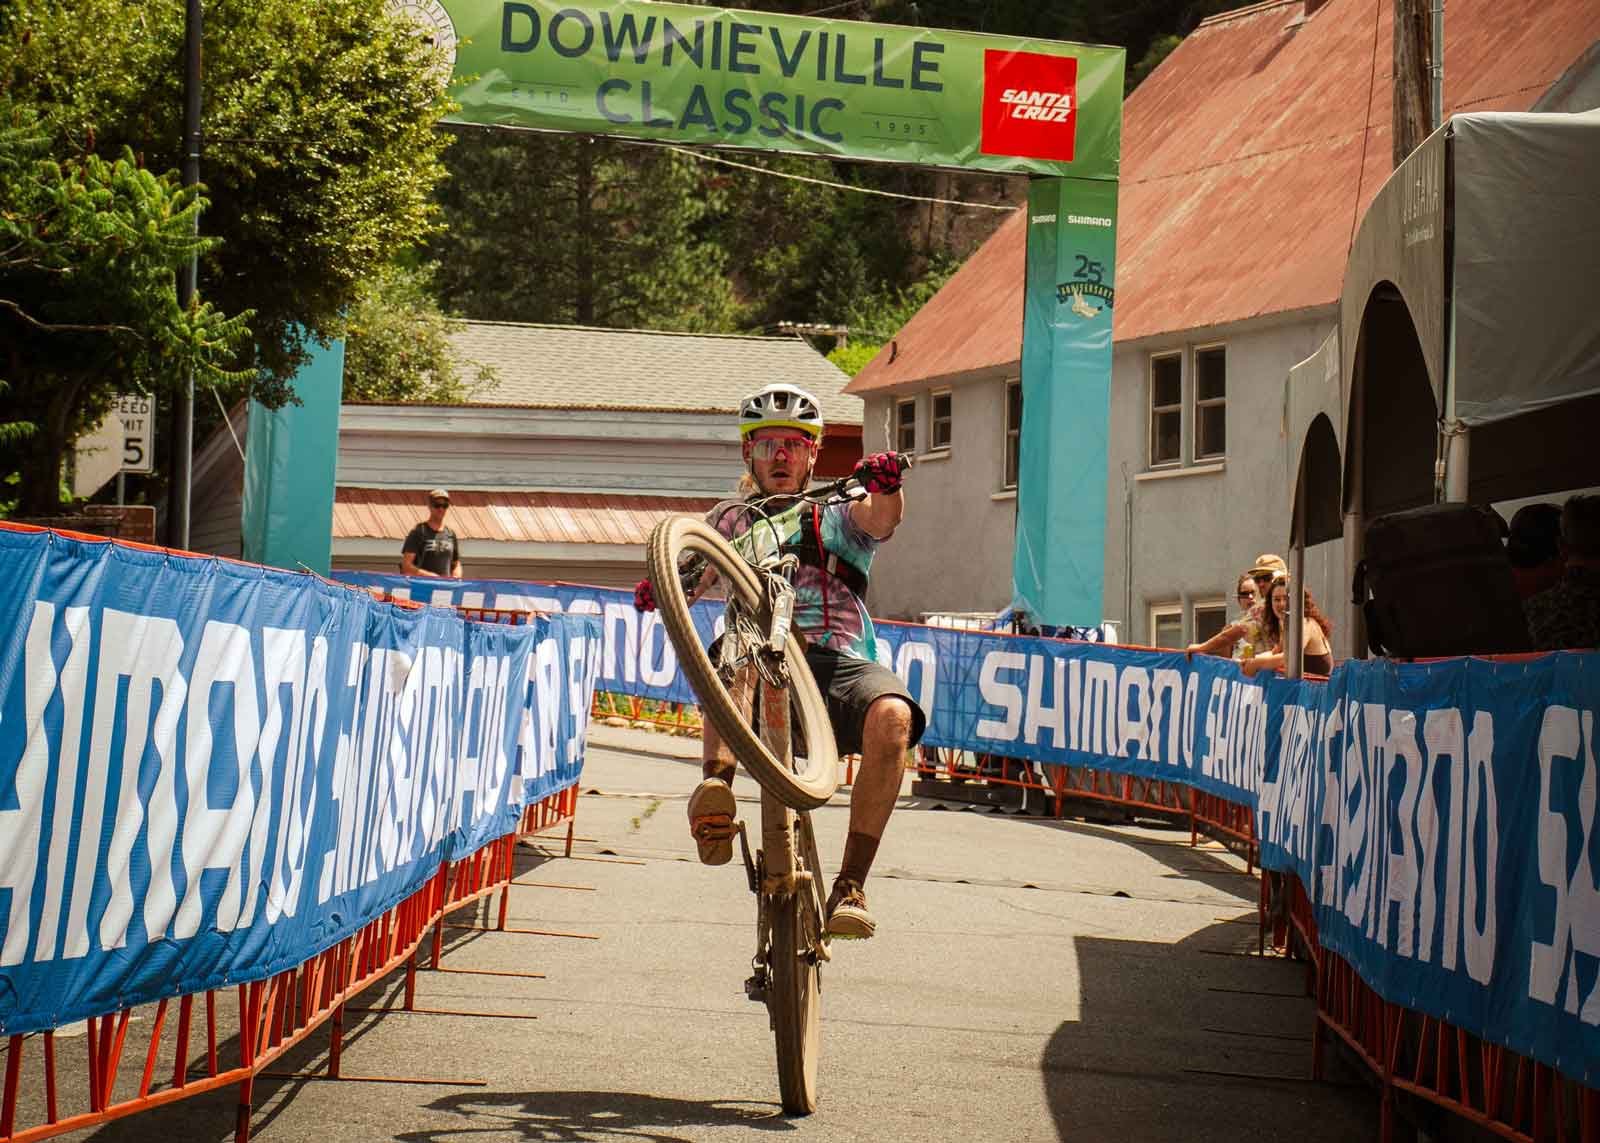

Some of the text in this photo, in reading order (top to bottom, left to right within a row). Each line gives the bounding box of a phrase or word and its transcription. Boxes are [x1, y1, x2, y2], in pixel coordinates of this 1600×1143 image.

[502, 3, 945, 93] DOWNIEVILLE
[1000, 88, 1071, 108] SANTA
[596, 79, 846, 143] CLASSIC
[1011, 104, 1071, 123] CRUZ
[874, 119, 927, 137] 1995
[1067, 215, 1112, 228] SHIMANO
[111, 401, 149, 415] PEED
[124, 438, 143, 465] 5
[976, 651, 1198, 769] SHIMANO
[0, 600, 328, 967] HIMANO
